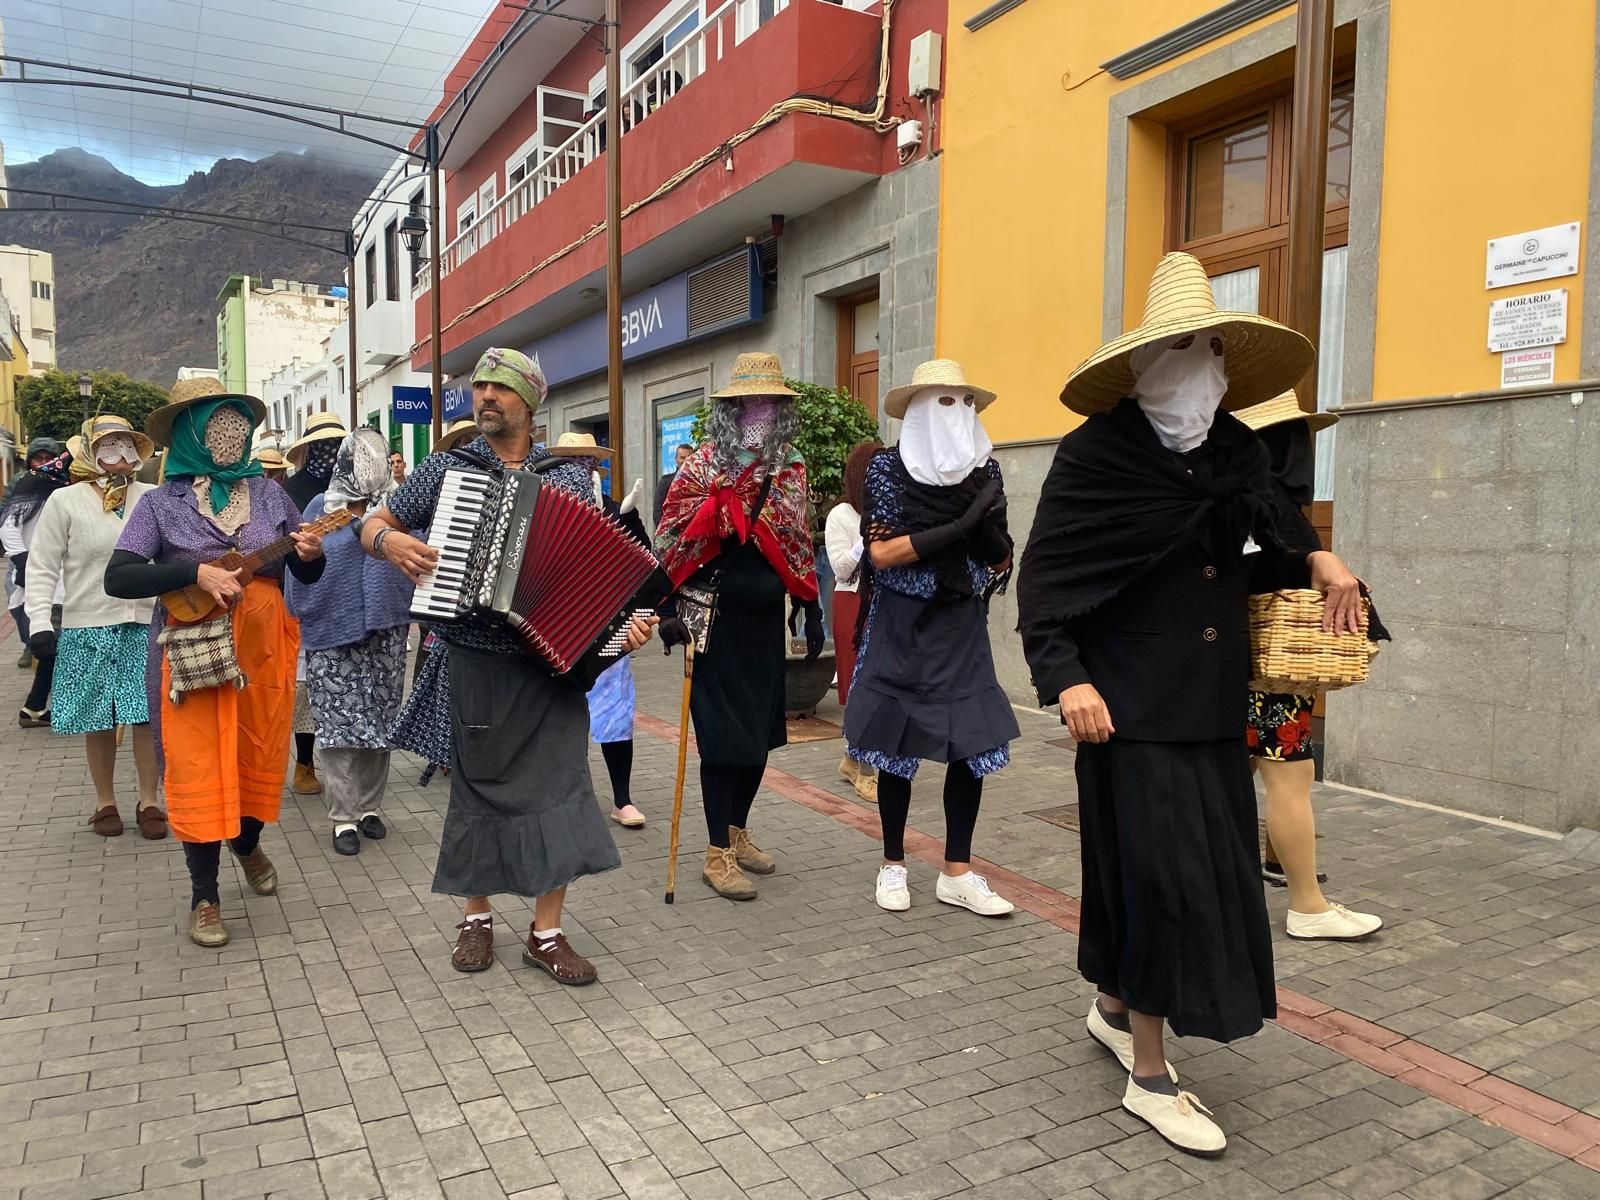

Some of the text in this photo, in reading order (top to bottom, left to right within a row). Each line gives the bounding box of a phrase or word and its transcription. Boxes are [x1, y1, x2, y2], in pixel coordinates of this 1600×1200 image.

[1494, 259, 1527, 271] GERMAINE
[1532, 252, 1569, 264] CAPUCCINI
[1505, 293, 1551, 308] HORARIO
[621, 296, 663, 348] BBVA
[1504, 355, 1516, 364] LOS
[396, 400, 428, 410] BBVA
[445, 383, 465, 412] BBVA
